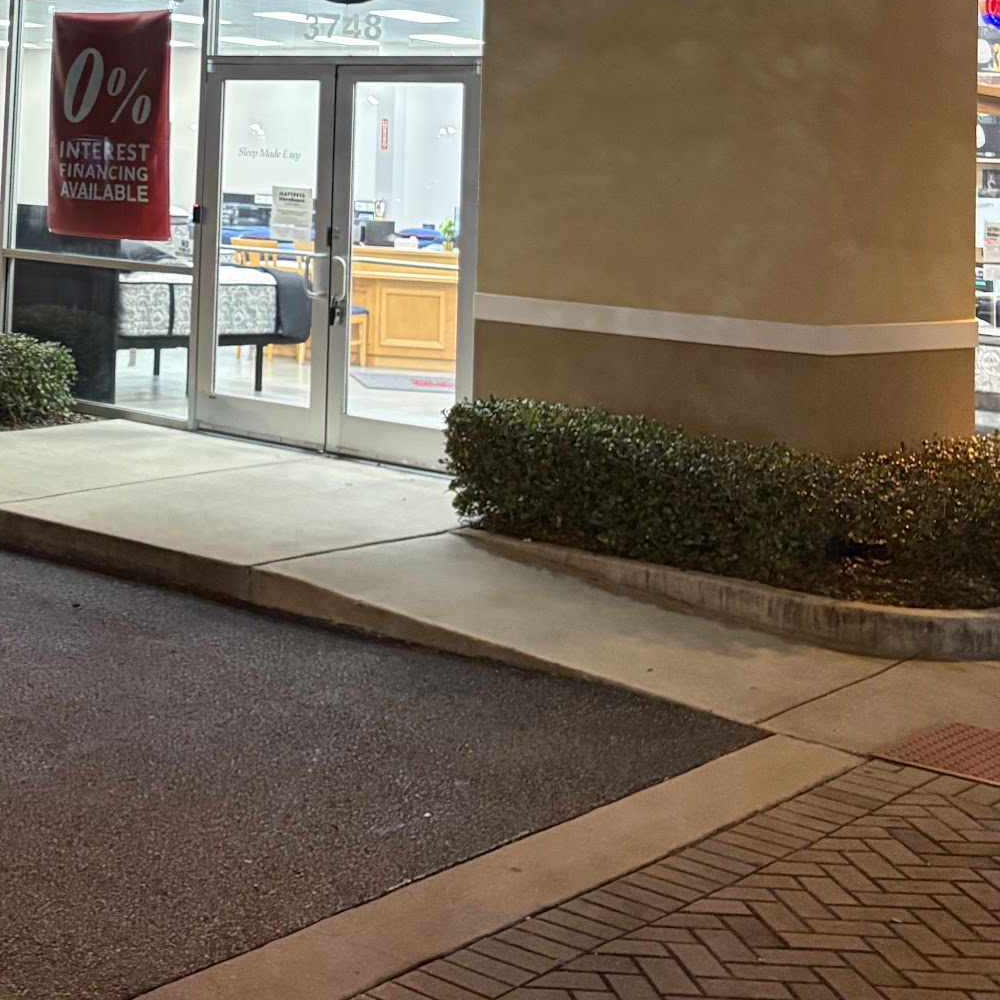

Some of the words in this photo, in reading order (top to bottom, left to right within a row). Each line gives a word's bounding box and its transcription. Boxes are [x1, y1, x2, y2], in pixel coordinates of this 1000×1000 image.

[302, 13, 382, 40] 3748
[63, 47, 152, 125] 0%
[59, 140, 150, 162] INTEREST
[238, 146, 258, 160] Sleep
[259, 148, 282, 158] Made
[282, 149, 301, 162] Easy
[59, 162, 149, 182] FINANCING
[60, 180, 149, 203] AVAILABLE
